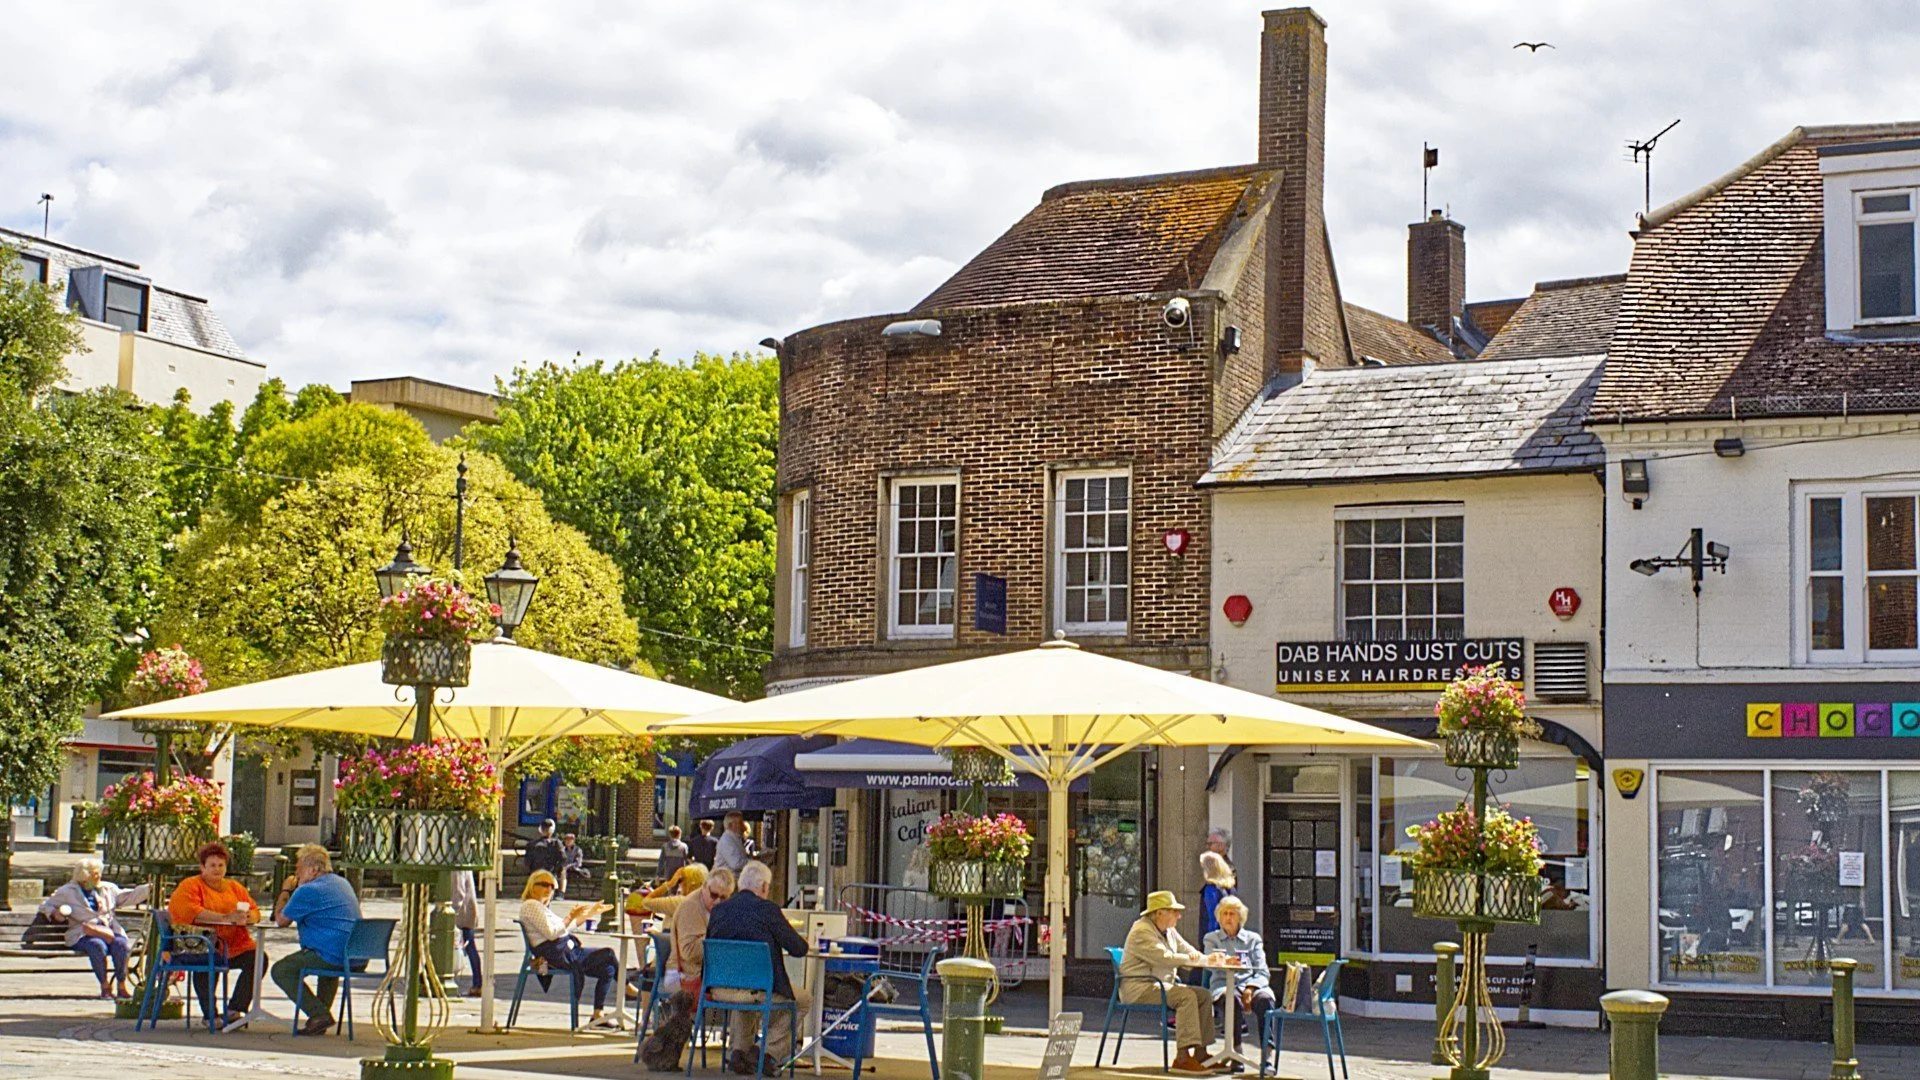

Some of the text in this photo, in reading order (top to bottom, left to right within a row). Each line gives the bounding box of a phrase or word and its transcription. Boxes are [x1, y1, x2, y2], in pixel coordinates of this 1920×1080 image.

[1278, 641, 1522, 664] DAB HANDS JUST CUTS
[1278, 667, 1522, 683] UNISEX HAIRDRESRS
[713, 760, 748, 792] CAFÉ
[891, 798, 938, 819] talian
